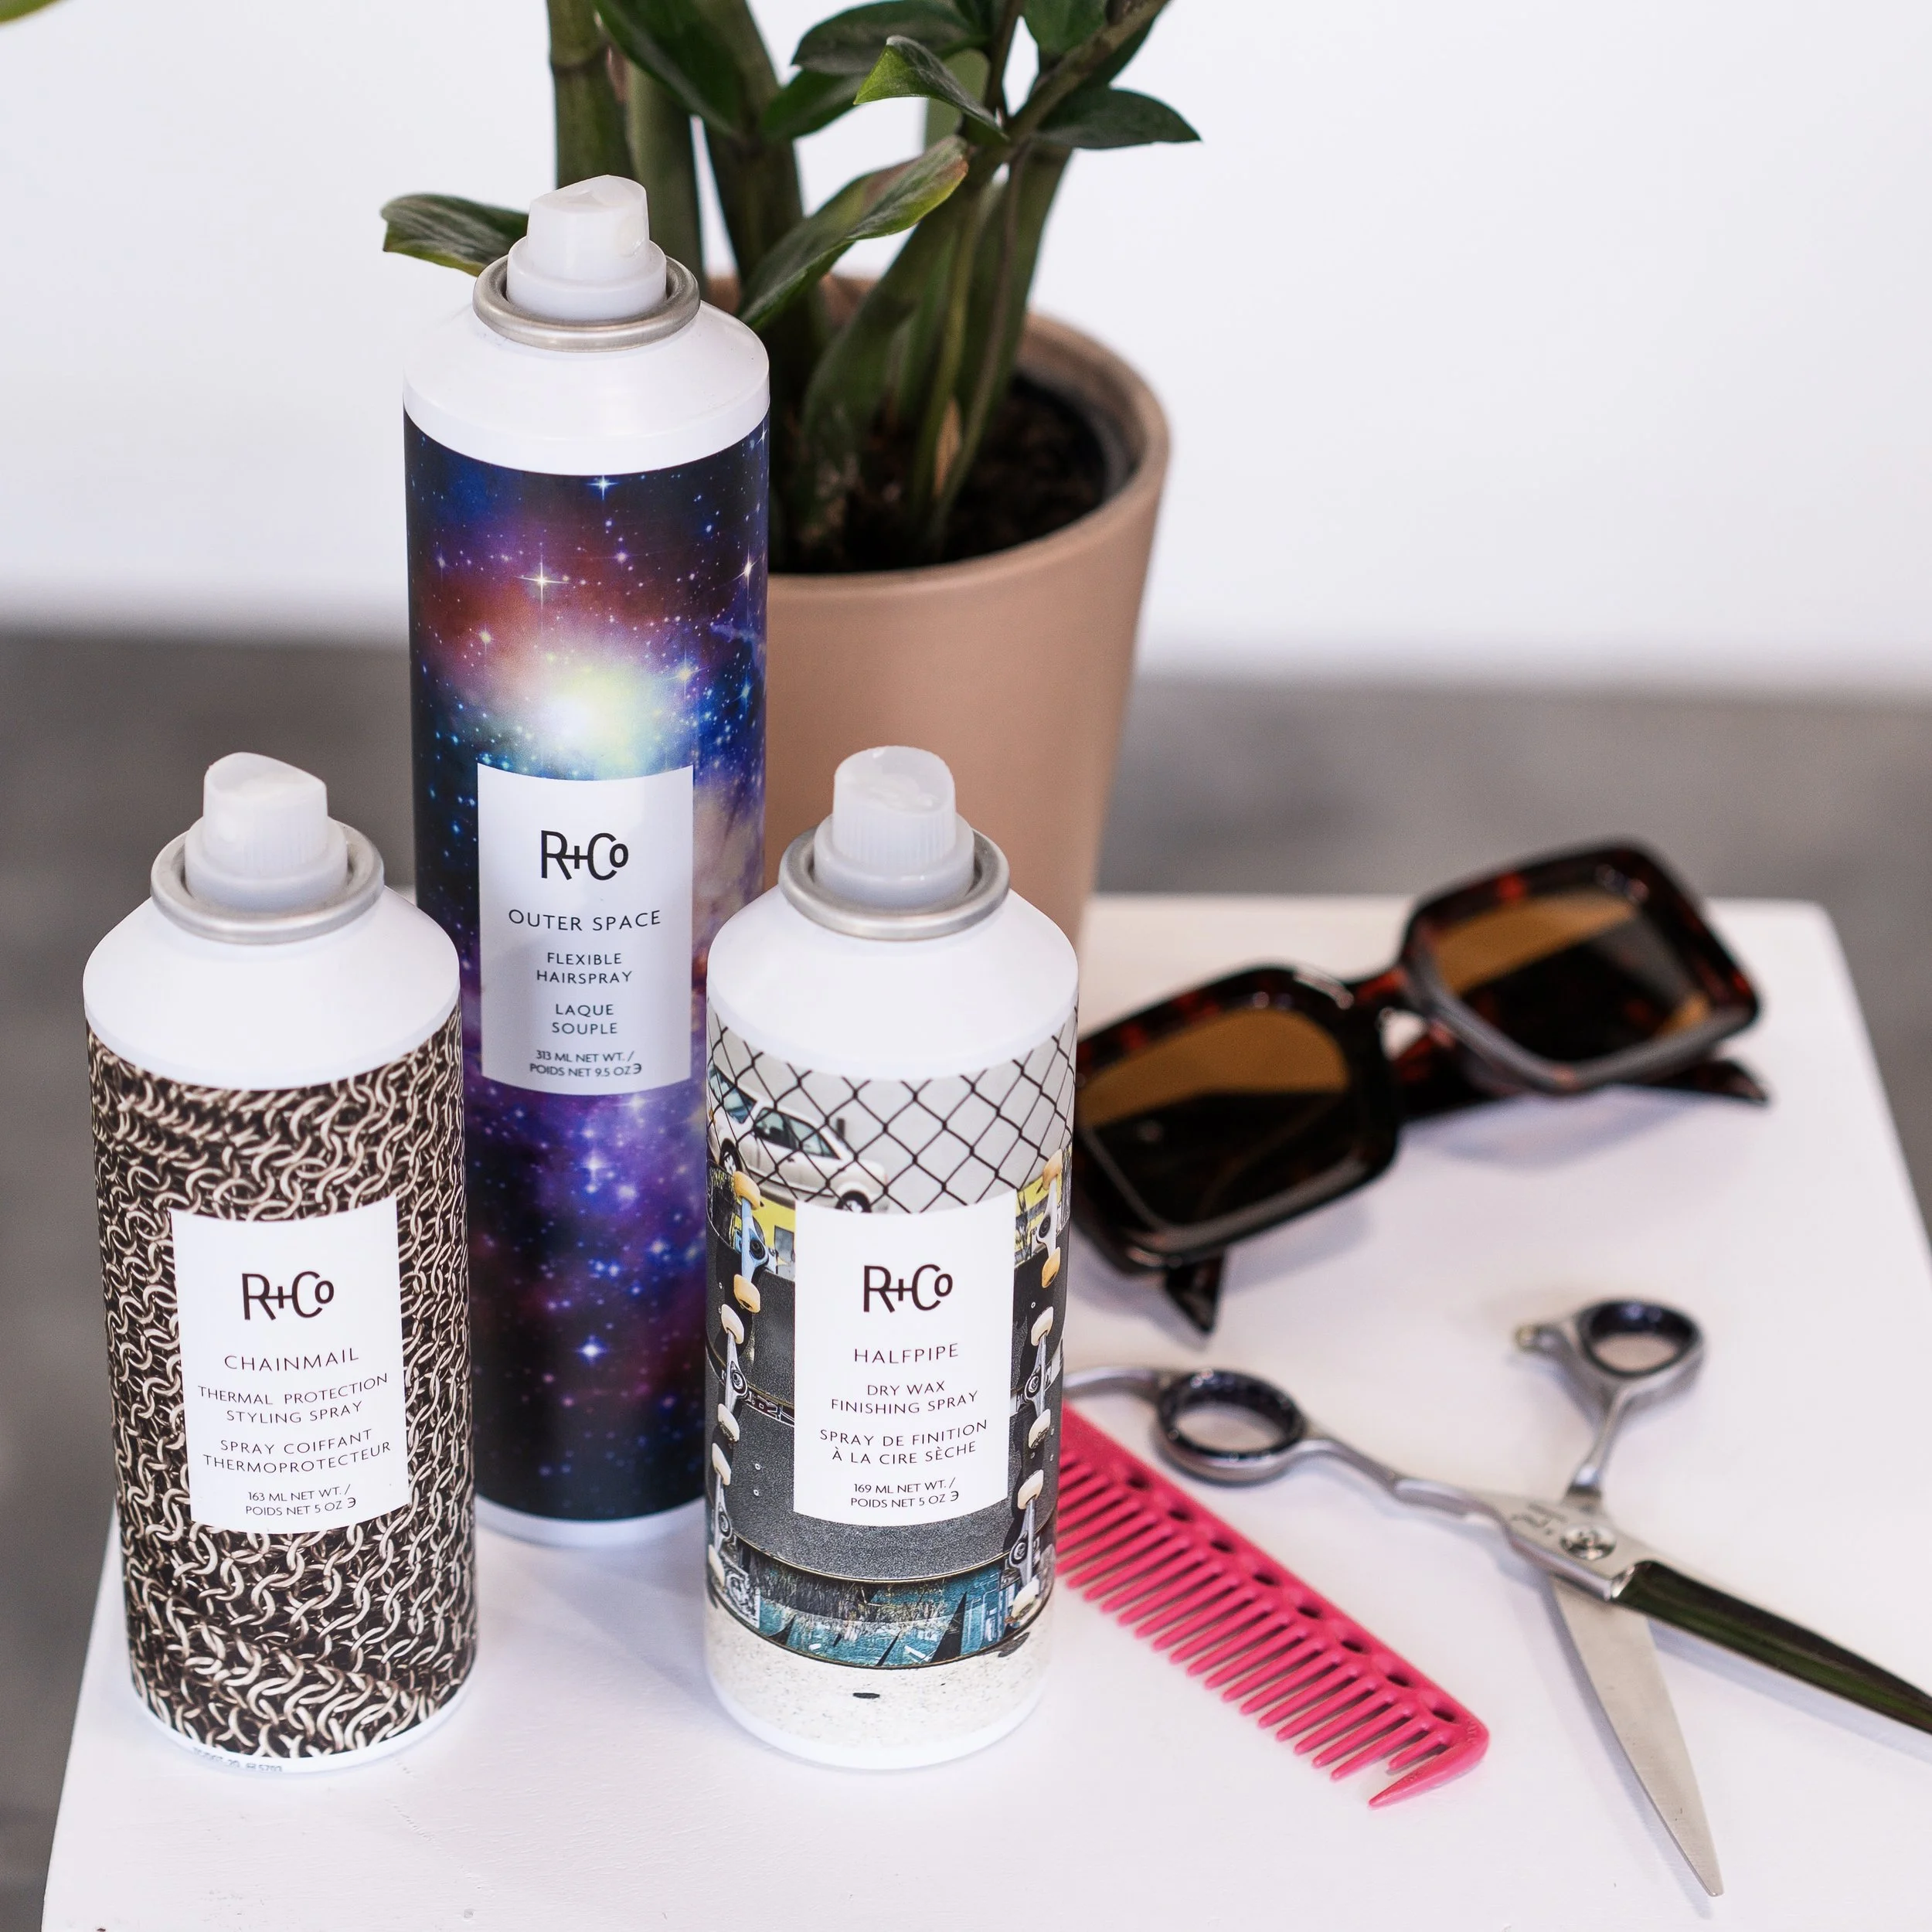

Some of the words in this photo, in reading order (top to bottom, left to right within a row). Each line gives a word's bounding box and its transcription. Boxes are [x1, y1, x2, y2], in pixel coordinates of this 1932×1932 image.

[540, 829, 629, 882] R+Co
[508, 909, 583, 932] OUTER
[592, 910, 662, 931] SPACE
[546, 951, 623, 966] FLEXIBLE
[536, 969, 633, 985] HAIRSPRAY
[555, 1003, 614, 1018] LAQUE
[551, 1022, 618, 1036] SOUPLE
[536, 1049, 552, 1061] 313
[554, 1053, 573, 1063] ML
[575, 1053, 600, 1063] NET
[529, 1063, 566, 1077] POIDS
[568, 1067, 592, 1077] NET
[613, 1066, 631, 1077] OZ
[241, 1270, 335, 1321] R+Co
[862, 1264, 954, 1314] R+Co
[224, 1347, 359, 1372] CHAINMAIL
[854, 1342, 959, 1365] HALFPIPE
[197, 1384, 274, 1406] THERMAL
[284, 1372, 388, 1405] PROTECTION
[867, 1384, 901, 1396] DRY
[906, 1380, 946, 1396] WAX
[226, 1410, 301, 1424] STYLING
[309, 1400, 362, 1423] SPRAY
[831, 1398, 920, 1415] FINISHING
[927, 1390, 978, 1413] SPRAY
[220, 1439, 276, 1456] SPRAY
[284, 1428, 372, 1454] COIFFANT
[819, 1429, 876, 1447] SPRAY
[883, 1435, 905, 1447] DE
[912, 1419, 987, 1447] FINITION
[202, 1440, 391, 1475] THERMOPROTECTEUR
[832, 1446, 842, 1462] À
[850, 1452, 872, 1465] LA
[879, 1452, 918, 1466] CIRE
[924, 1440, 977, 1463] SÈCHE
[247, 1492, 266, 1502] 163
[268, 1492, 288, 1502] ML
[291, 1490, 315, 1502] NET
[318, 1486, 342, 1498] WT.
[853, 1483, 872, 1493] 169
[875, 1485, 894, 1494] ML
[896, 1483, 922, 1494] NET
[923, 1479, 946, 1491] WT.
[245, 1505, 283, 1516] POIDS
[286, 1505, 311, 1516] NET
[315, 1504, 321, 1514] 5
[324, 1500, 343, 1512] OZ
[850, 1497, 888, 1509] POIDS
[891, 1498, 916, 1509] NET
[918, 1497, 925, 1506] 5
[927, 1493, 946, 1505] OZ
